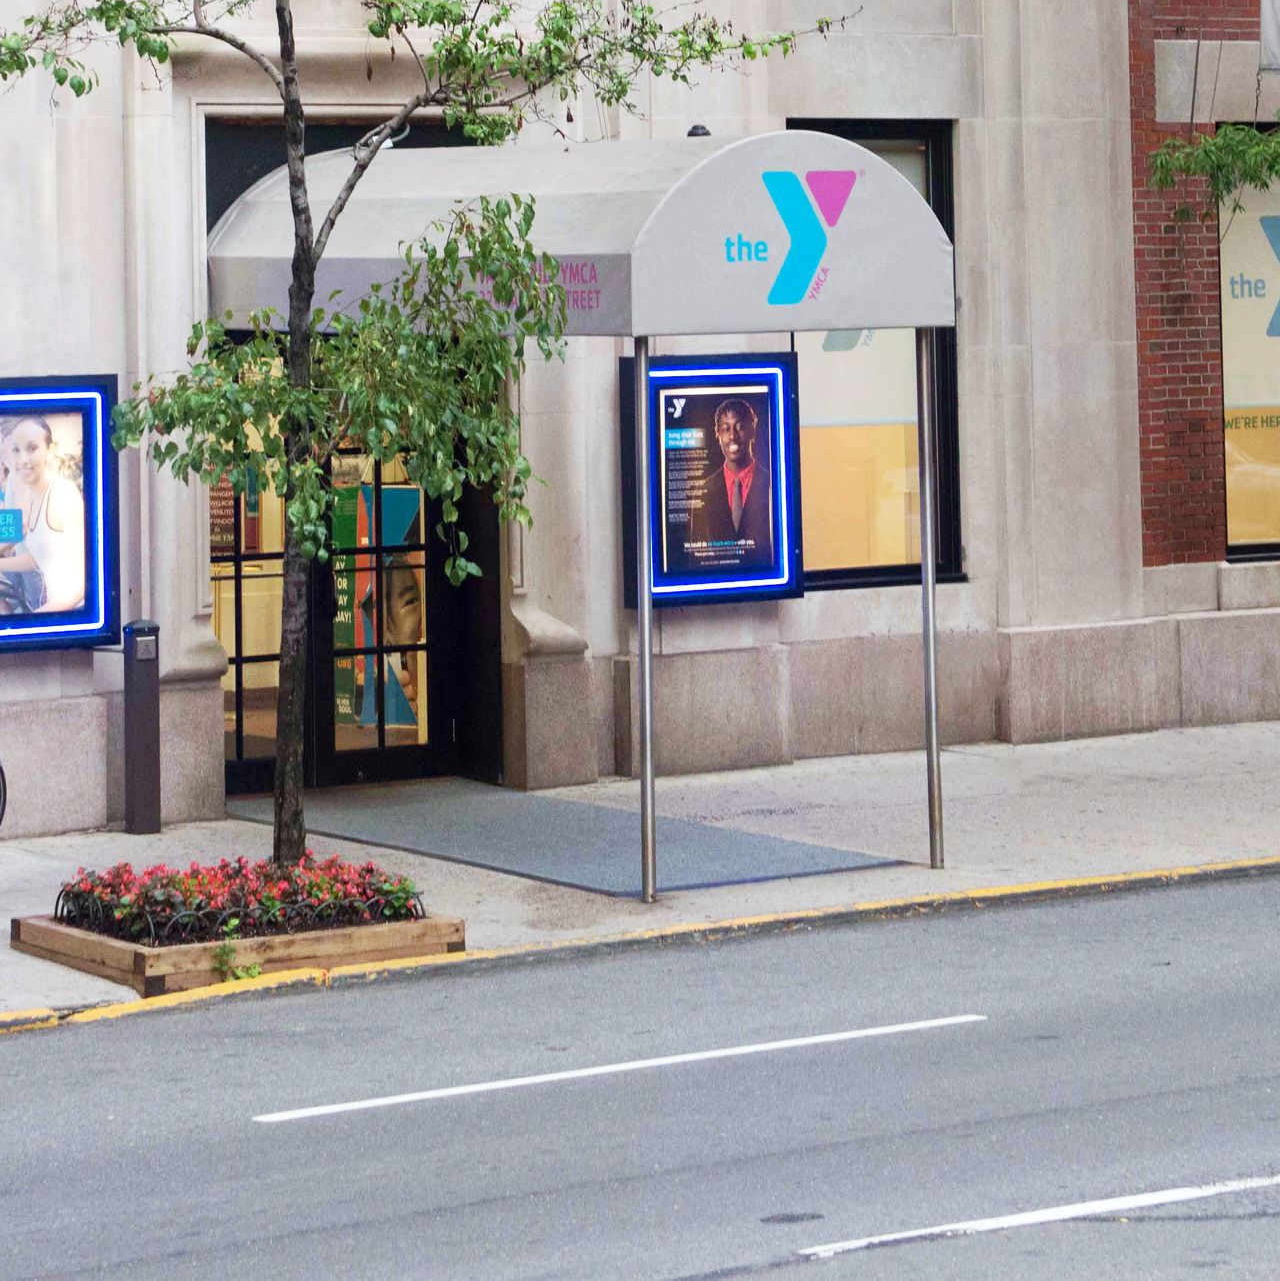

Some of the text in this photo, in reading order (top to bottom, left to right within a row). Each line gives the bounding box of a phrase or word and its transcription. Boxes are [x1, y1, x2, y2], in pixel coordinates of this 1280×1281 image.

[724, 232, 768, 263] the
[560, 262, 598, 285] YMCA
[808, 266, 831, 301] YMCA
[1229, 272, 1266, 298] the
[562, 290, 601, 310] TREET
[1225, 416, 1258, 429] WE'RE
